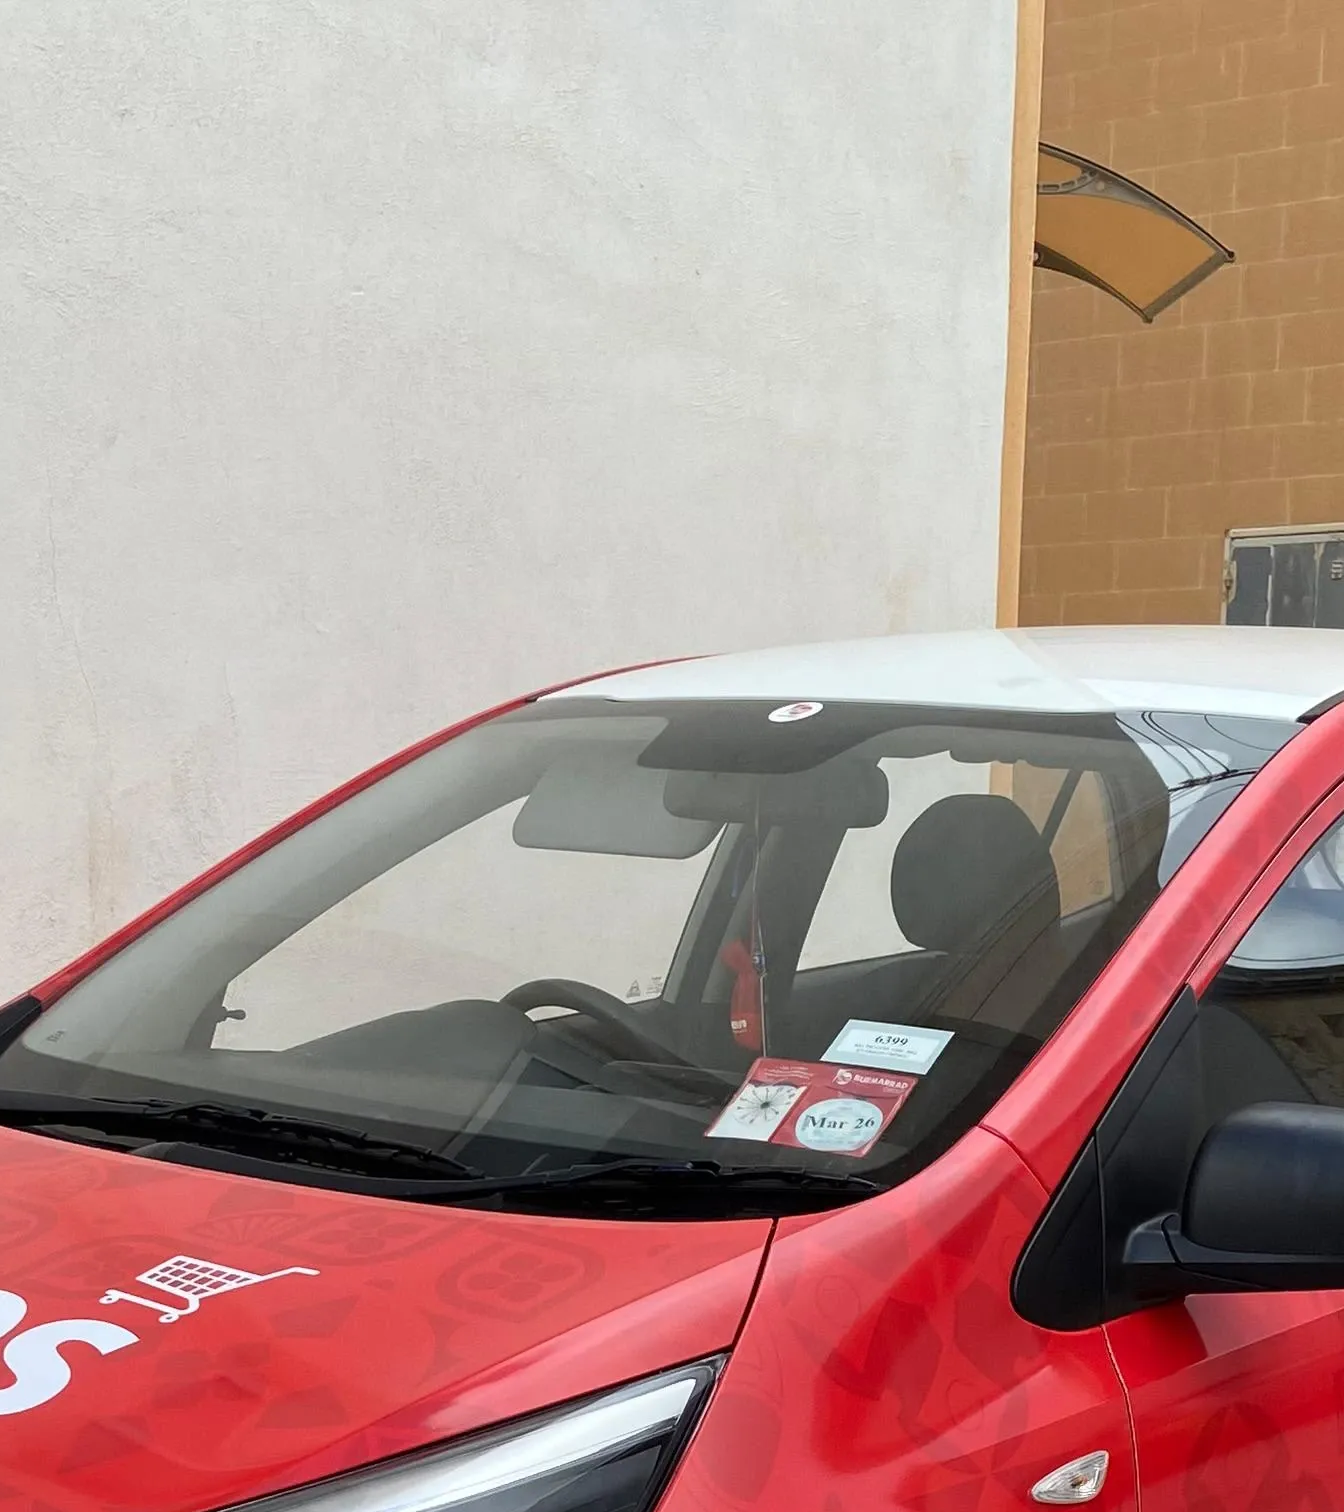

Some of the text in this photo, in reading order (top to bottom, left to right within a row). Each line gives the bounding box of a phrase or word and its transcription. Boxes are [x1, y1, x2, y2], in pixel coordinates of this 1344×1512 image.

[874, 1035, 909, 1046] 6399
[807, 1114, 876, 1130] Mar 26
